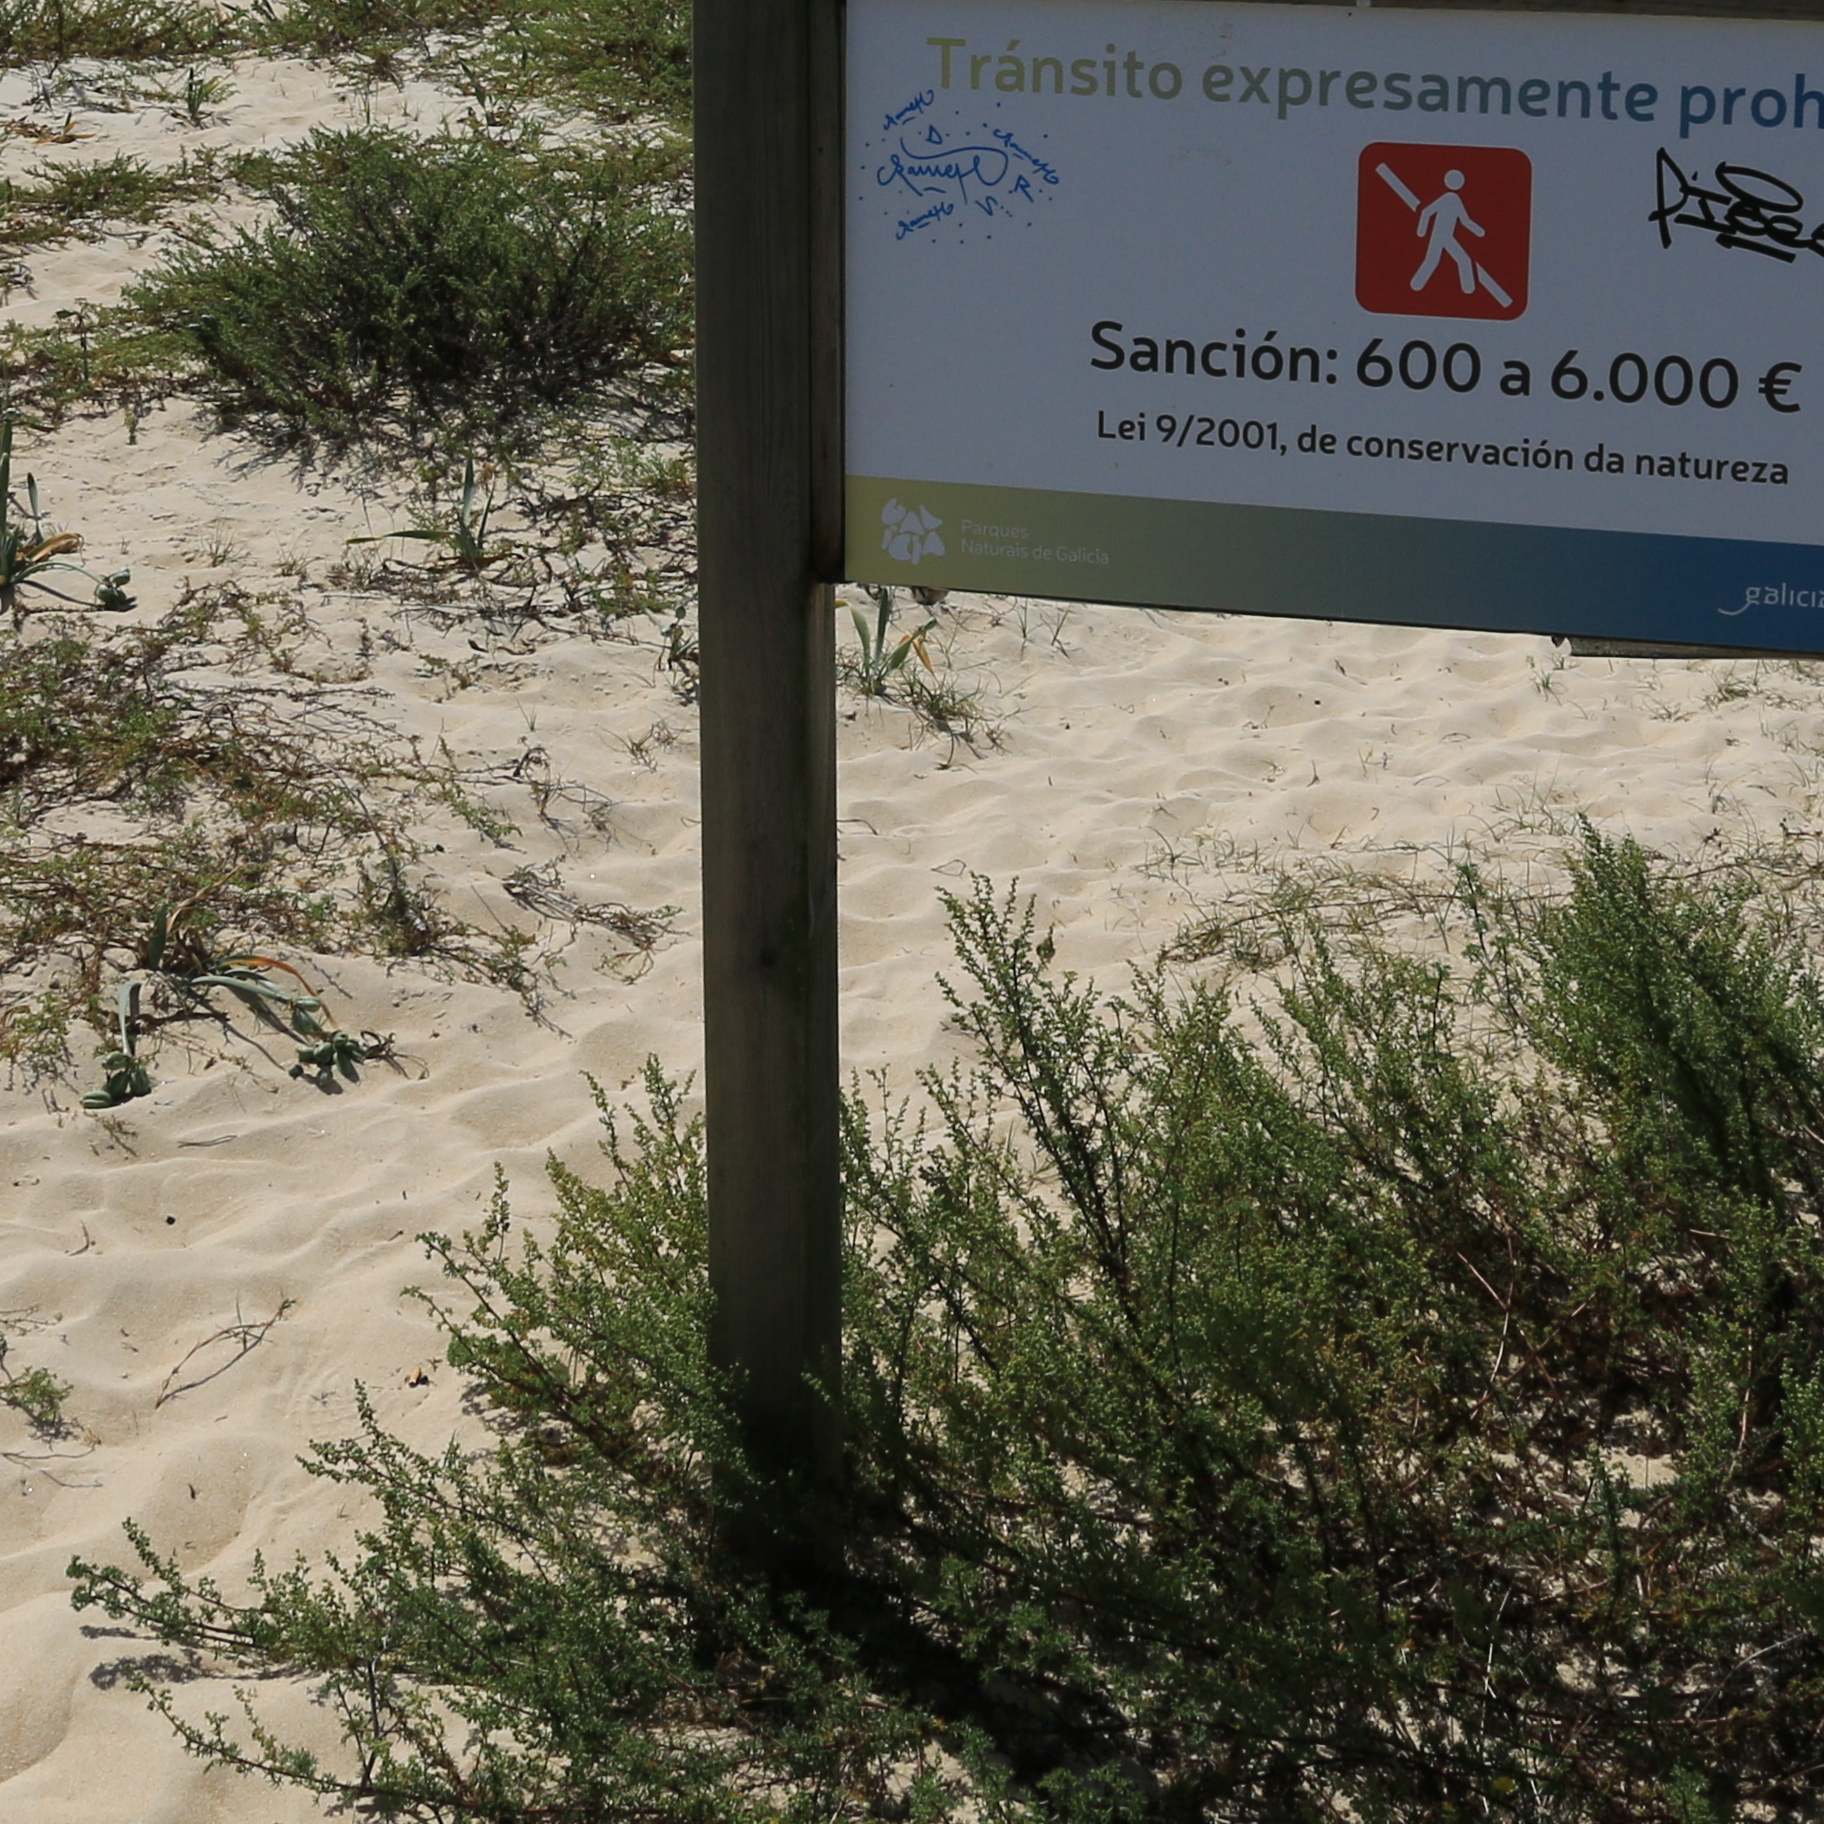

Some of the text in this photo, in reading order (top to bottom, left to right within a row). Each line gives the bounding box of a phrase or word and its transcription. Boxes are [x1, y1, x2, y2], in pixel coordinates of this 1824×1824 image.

[926, 37, 1182, 100] Tránsito
[1202, 63, 1658, 122] expresamente
[1090, 320, 1803, 413] Sanción: 600 a 6.000 €
[1098, 411, 1789, 484] Lei 9/2001, de conservación da natureza
[961, 519, 1030, 541] Parques
[961, 540, 1110, 566] Naturais de Galicia
